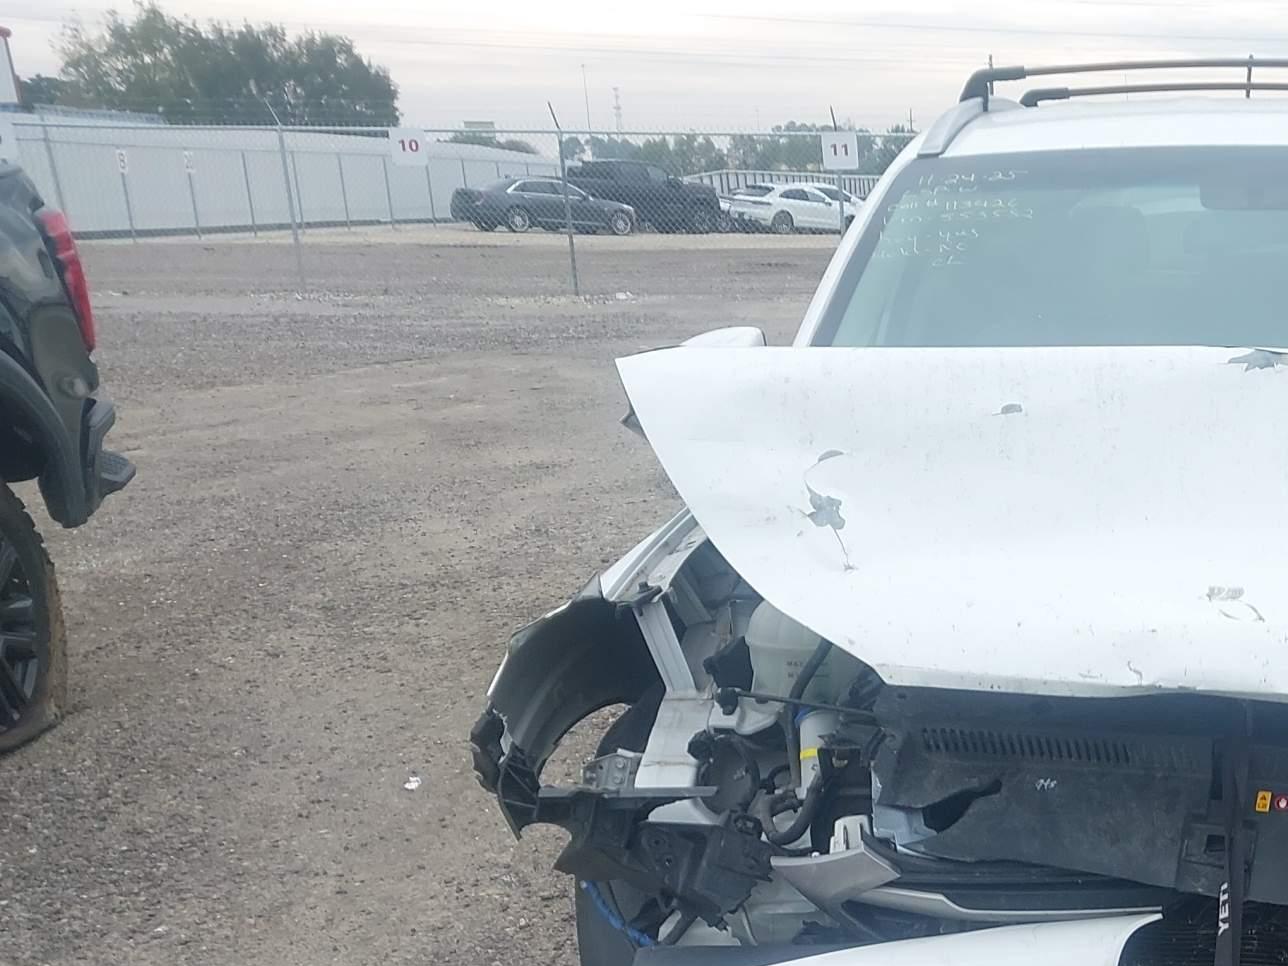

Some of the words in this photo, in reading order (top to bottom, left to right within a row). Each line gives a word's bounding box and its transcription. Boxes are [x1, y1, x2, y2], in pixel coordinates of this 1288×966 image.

[399, 139, 419, 152] 10
[830, 143, 849, 156] 11
[1218, 882, 1230, 936] YETI
